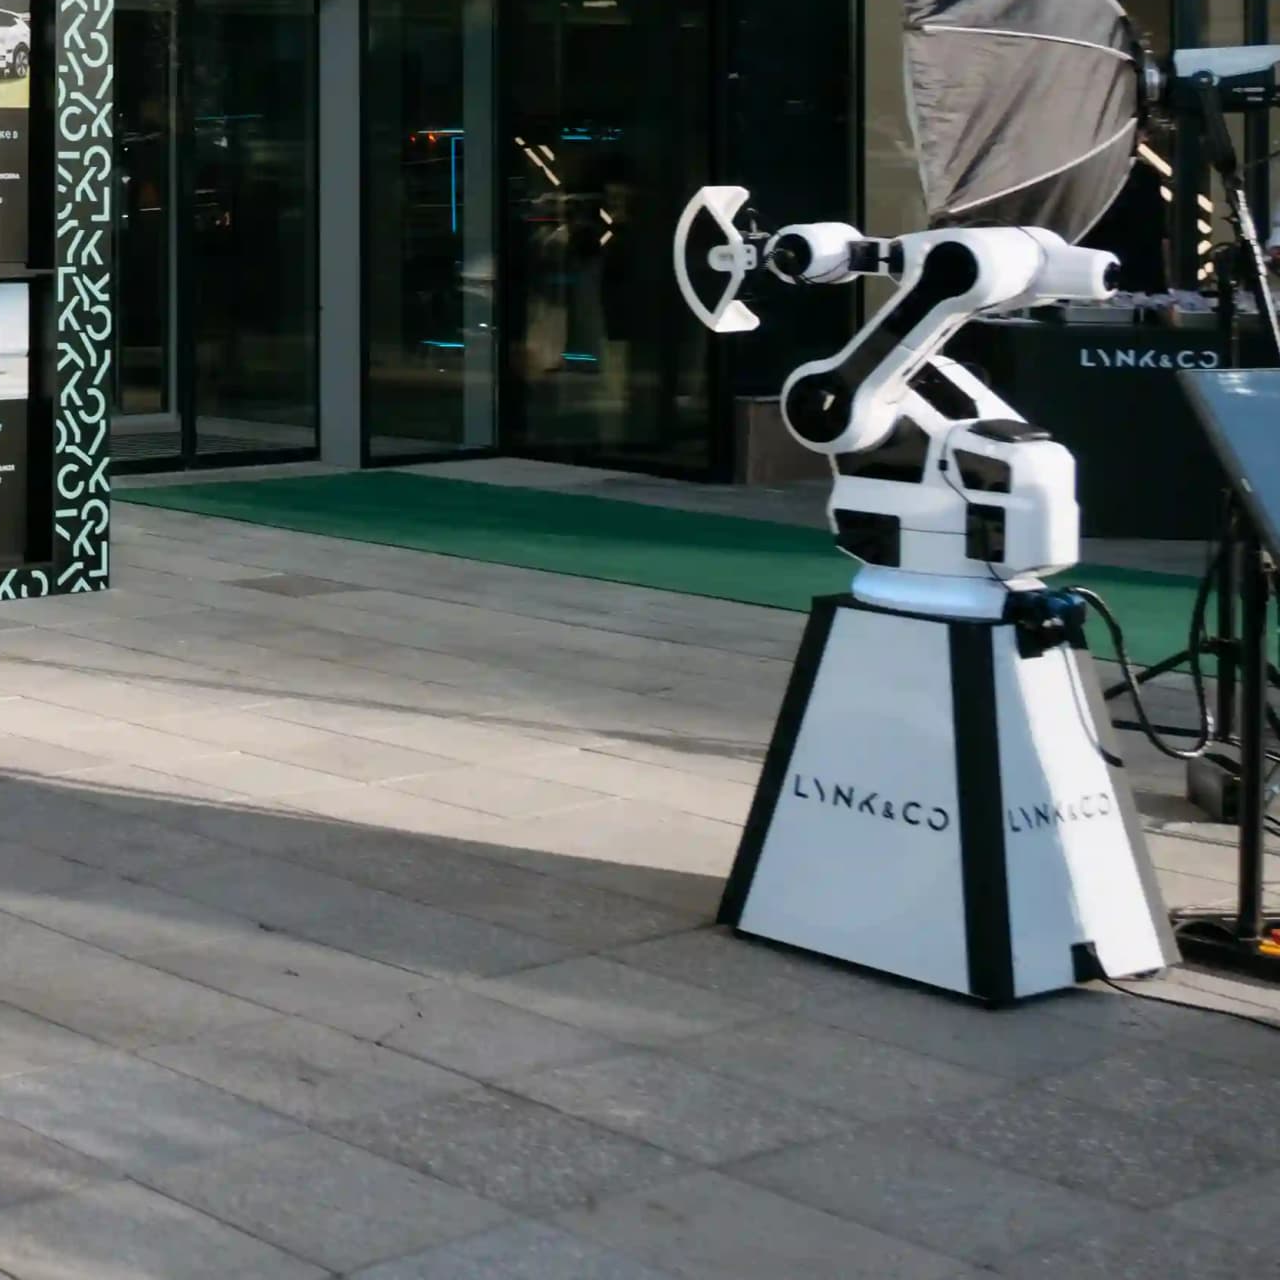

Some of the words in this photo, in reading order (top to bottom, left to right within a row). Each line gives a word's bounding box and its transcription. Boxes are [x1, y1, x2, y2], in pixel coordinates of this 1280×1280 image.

[12, 130, 18, 138] в
[1080, 349, 1219, 369] LYNK&CO
[794, 773, 952, 832] LYNK&CO
